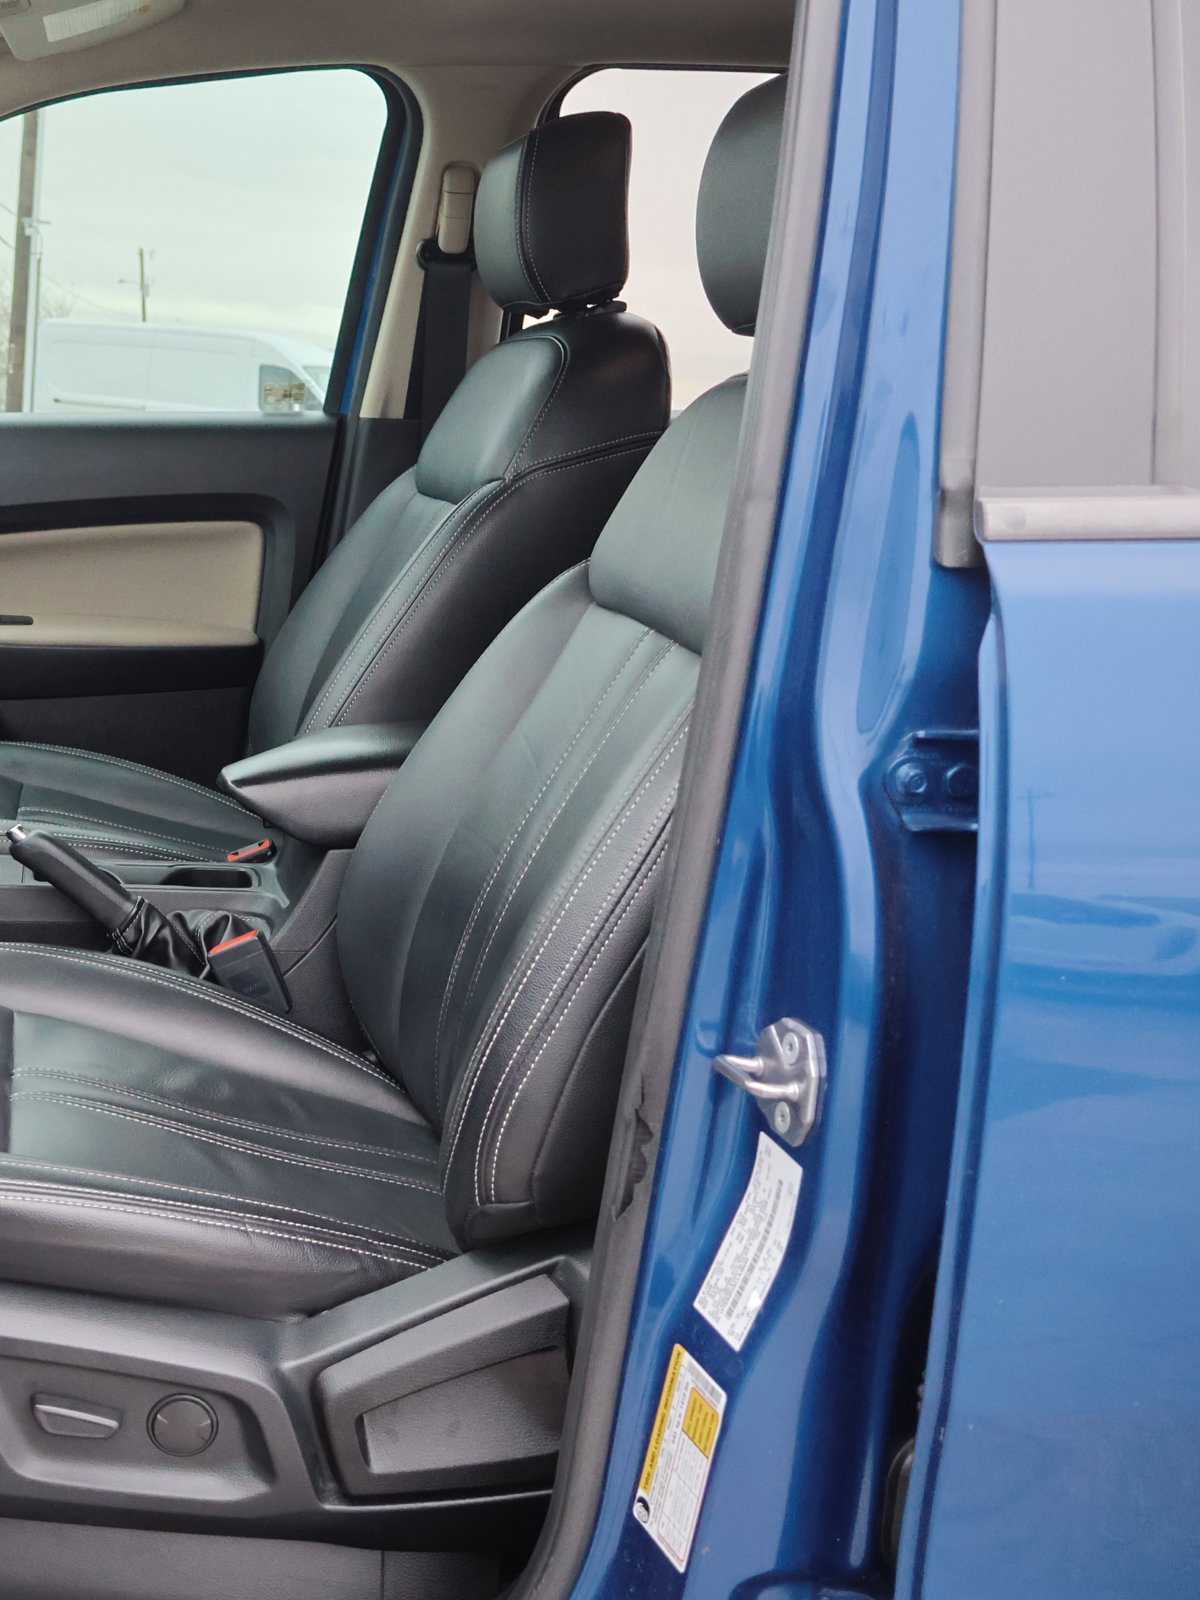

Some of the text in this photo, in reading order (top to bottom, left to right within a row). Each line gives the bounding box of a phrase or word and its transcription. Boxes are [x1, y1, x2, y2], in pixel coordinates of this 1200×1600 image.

[643, 1470, 652, 1490] TIRE
[653, 1412, 666, 1450] LOADING
[664, 1350, 681, 1410] INFORMATION
